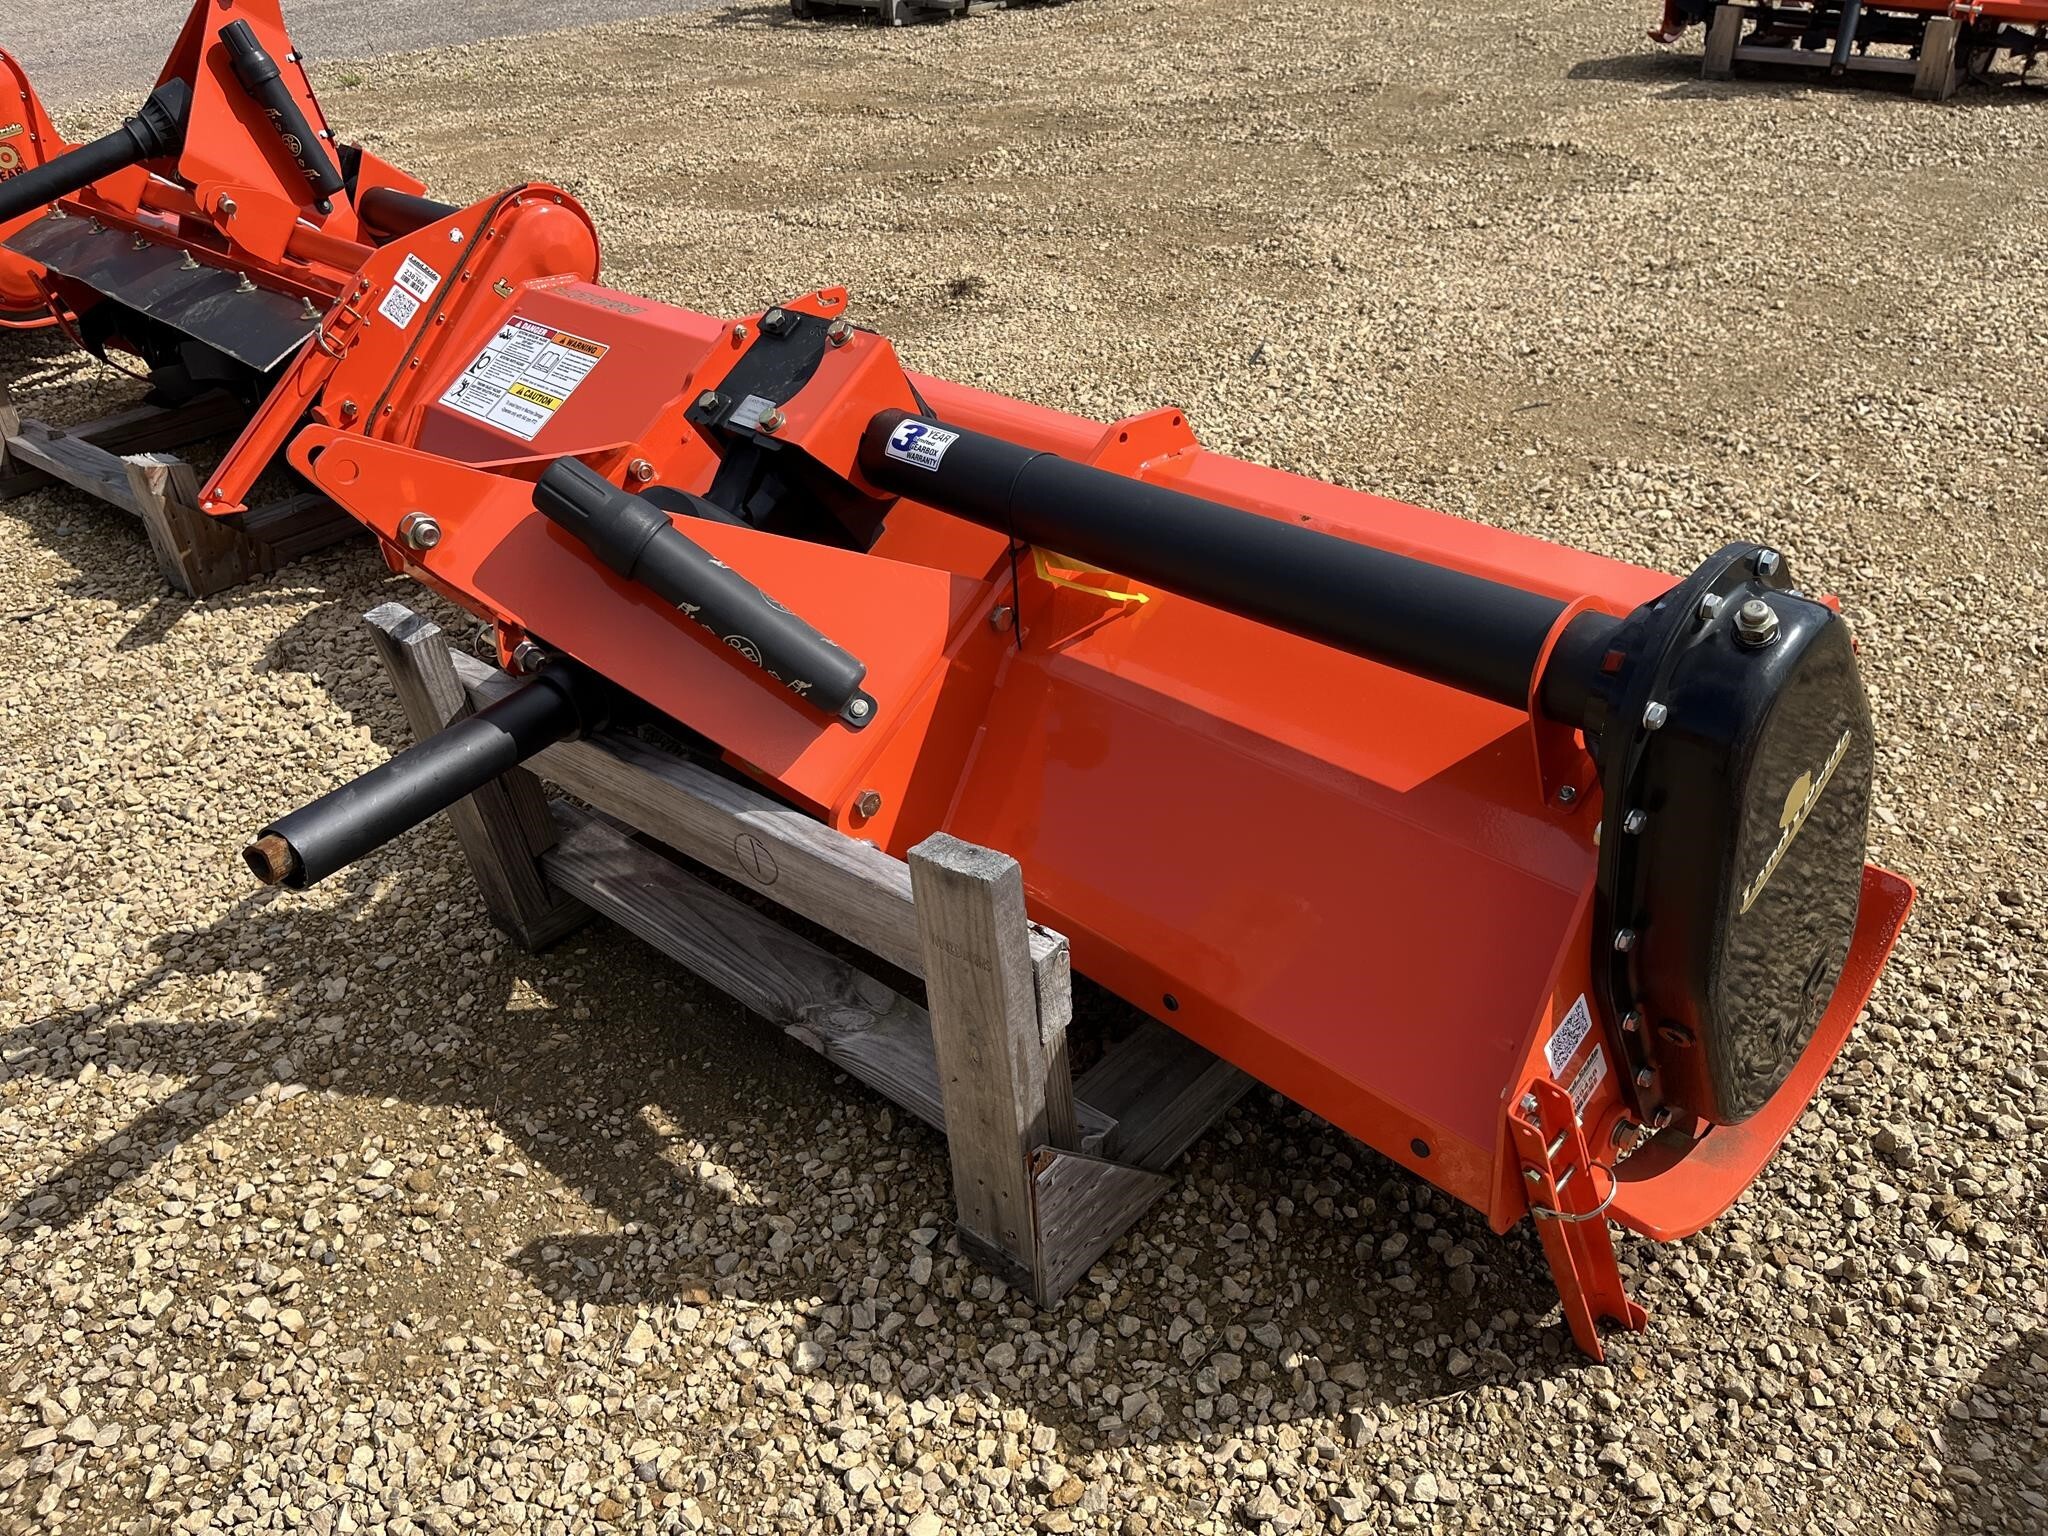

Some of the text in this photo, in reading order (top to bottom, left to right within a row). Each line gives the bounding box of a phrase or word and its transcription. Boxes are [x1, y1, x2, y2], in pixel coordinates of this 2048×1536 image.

[520, 322, 549, 337] DANGER
[565, 337, 598, 355] WARNING
[523, 389, 554, 406] CAUTION
[892, 424, 952, 452] 3 YEAR
[910, 443, 939, 457] GEARBOX
[906, 452, 938, 466] WARRANTY
